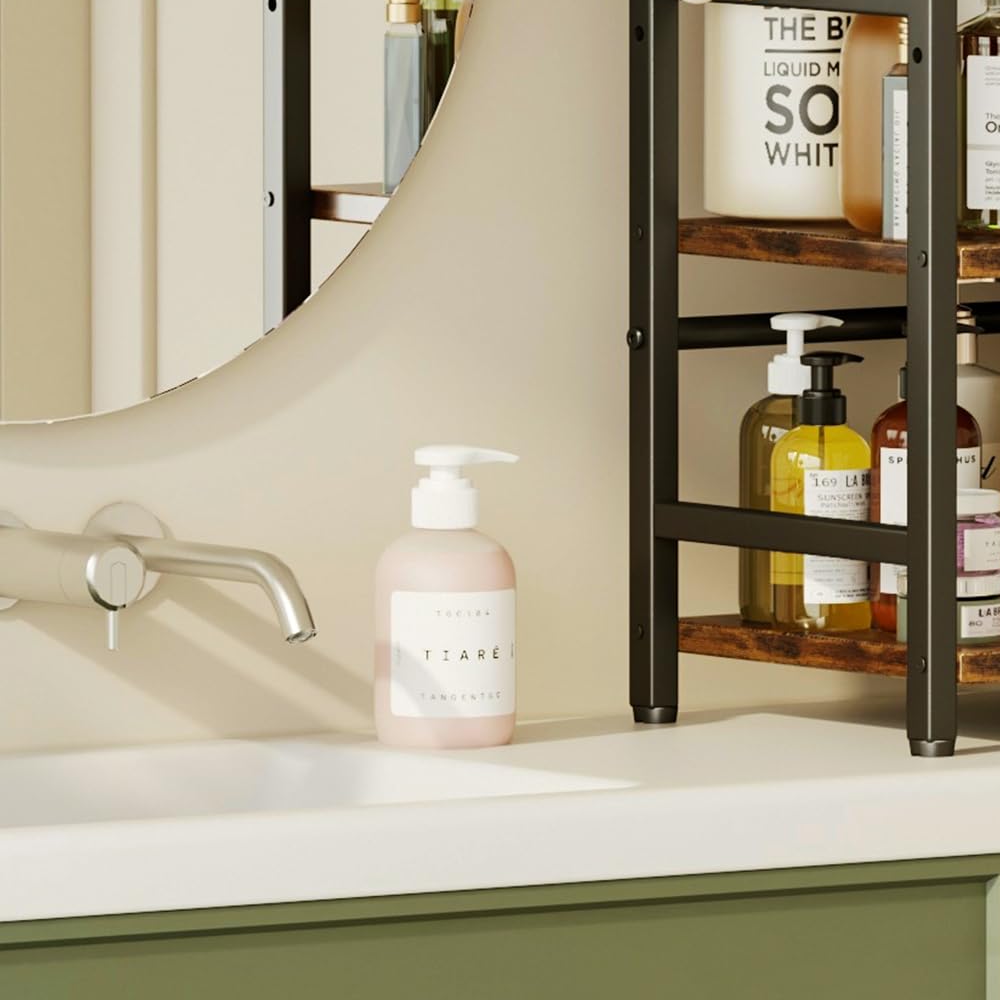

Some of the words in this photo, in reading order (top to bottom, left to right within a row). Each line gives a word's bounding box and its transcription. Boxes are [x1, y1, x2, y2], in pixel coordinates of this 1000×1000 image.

[764, 16, 816, 41] THE
[764, 61, 821, 77] LIQUID
[765, 84, 840, 136] SO
[985, 112, 1000, 120] The
[765, 141, 839, 167] WHIT
[814, 477, 838, 488] 169
